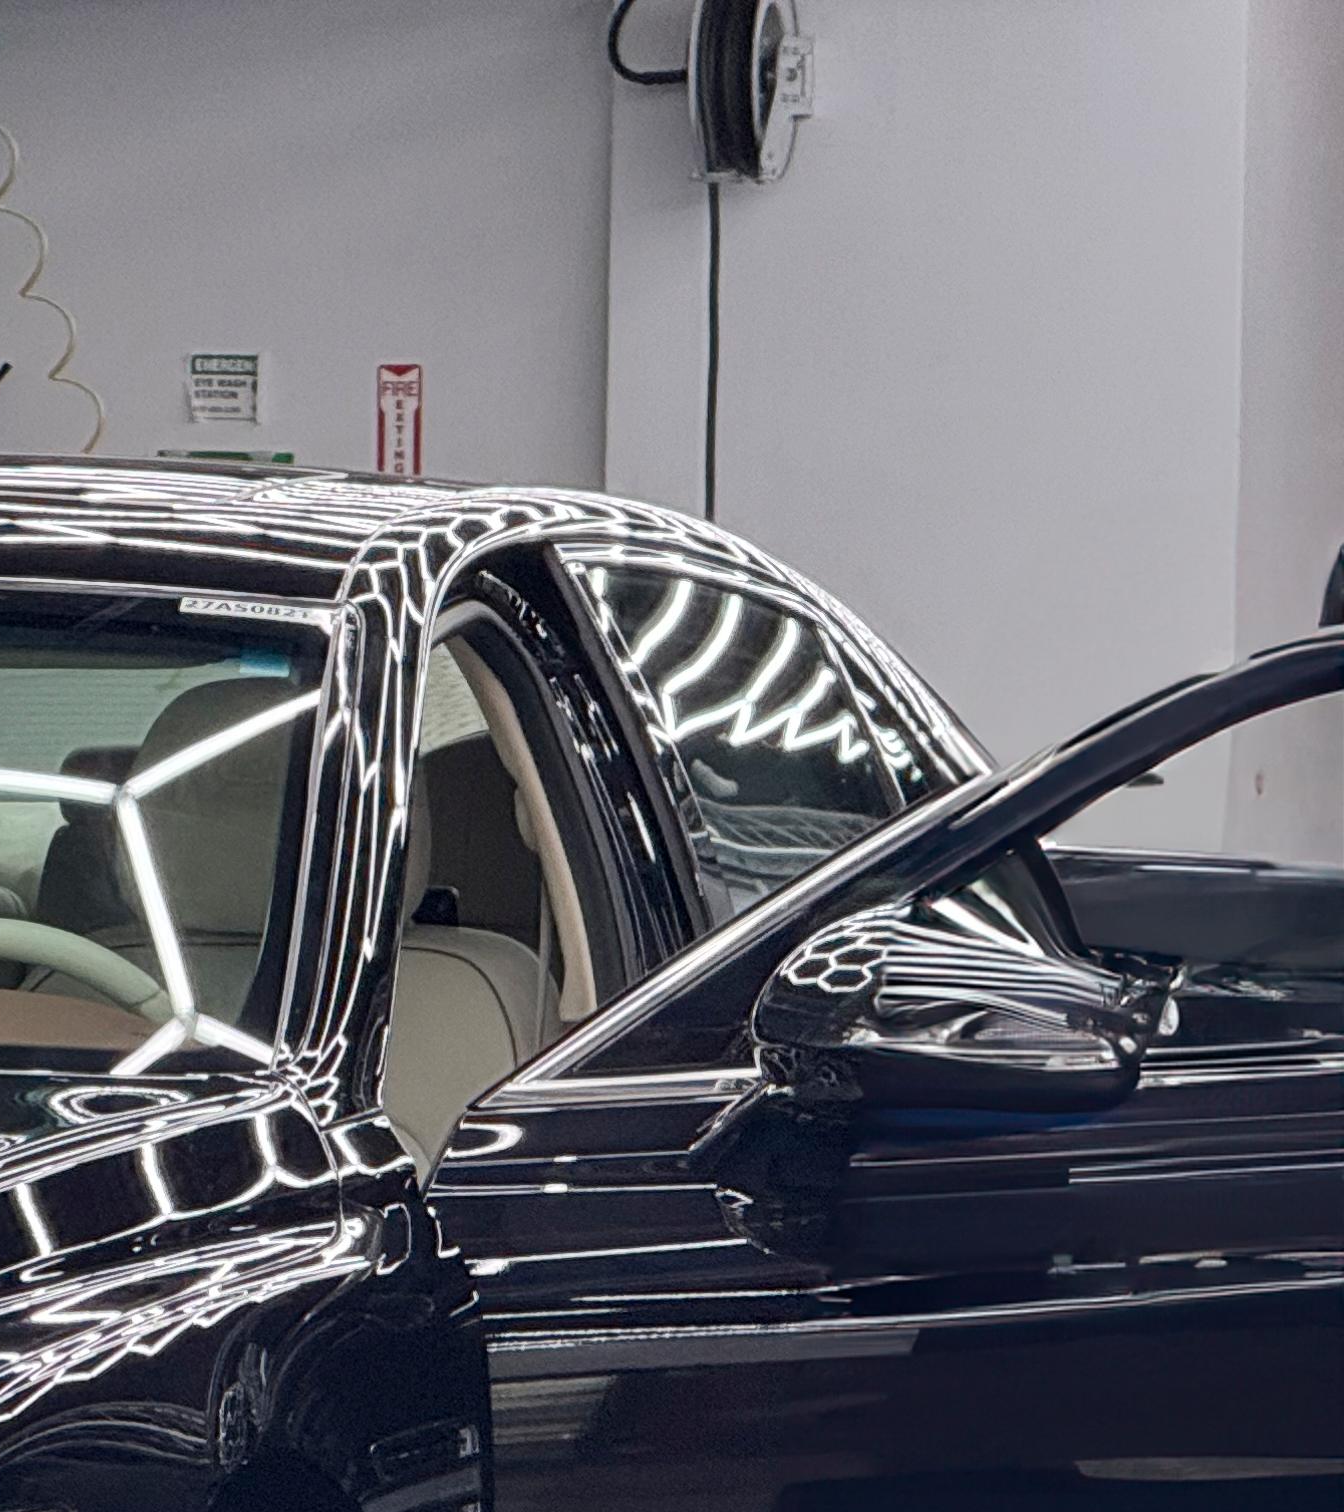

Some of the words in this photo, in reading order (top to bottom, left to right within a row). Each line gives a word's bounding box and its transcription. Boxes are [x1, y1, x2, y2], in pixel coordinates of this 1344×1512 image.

[194, 378, 214, 388] EYE
[217, 379, 247, 388] WASH
[380, 381, 419, 397] FIRE
